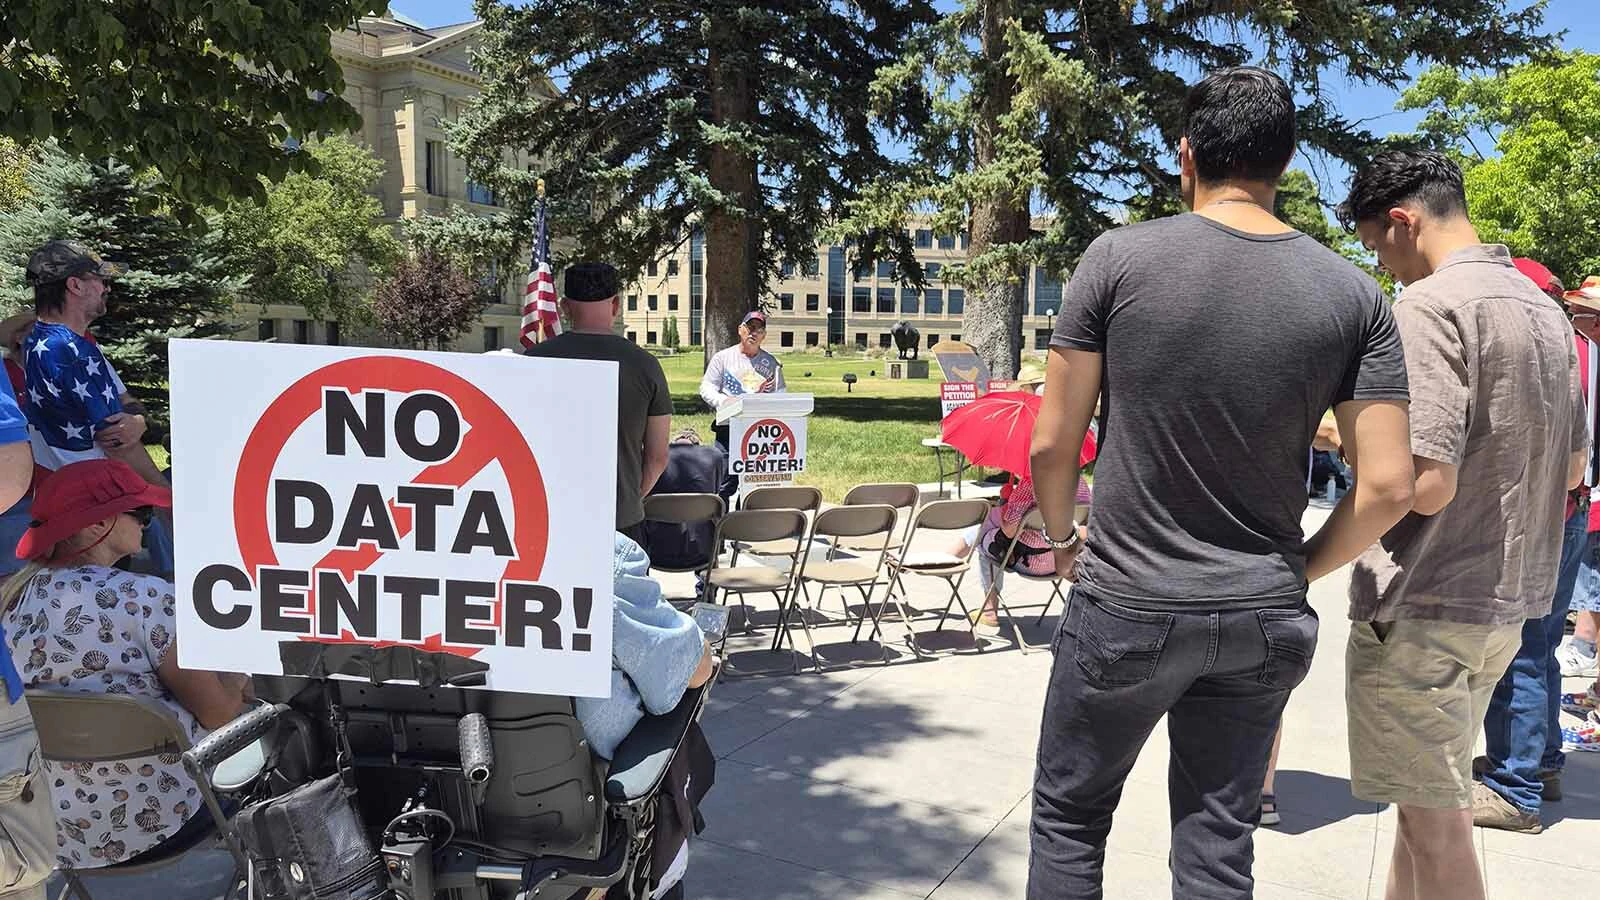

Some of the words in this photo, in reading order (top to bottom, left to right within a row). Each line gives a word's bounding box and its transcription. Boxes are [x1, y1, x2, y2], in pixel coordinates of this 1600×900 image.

[943, 391, 976, 400] PETITION
[324, 390, 460, 462] NO
[757, 425, 782, 438] NO
[748, 442, 790, 455] DATA
[732, 459, 803, 473] CENTER!
[274, 479, 515, 557] DATA
[192, 564, 593, 652] CENTER!
